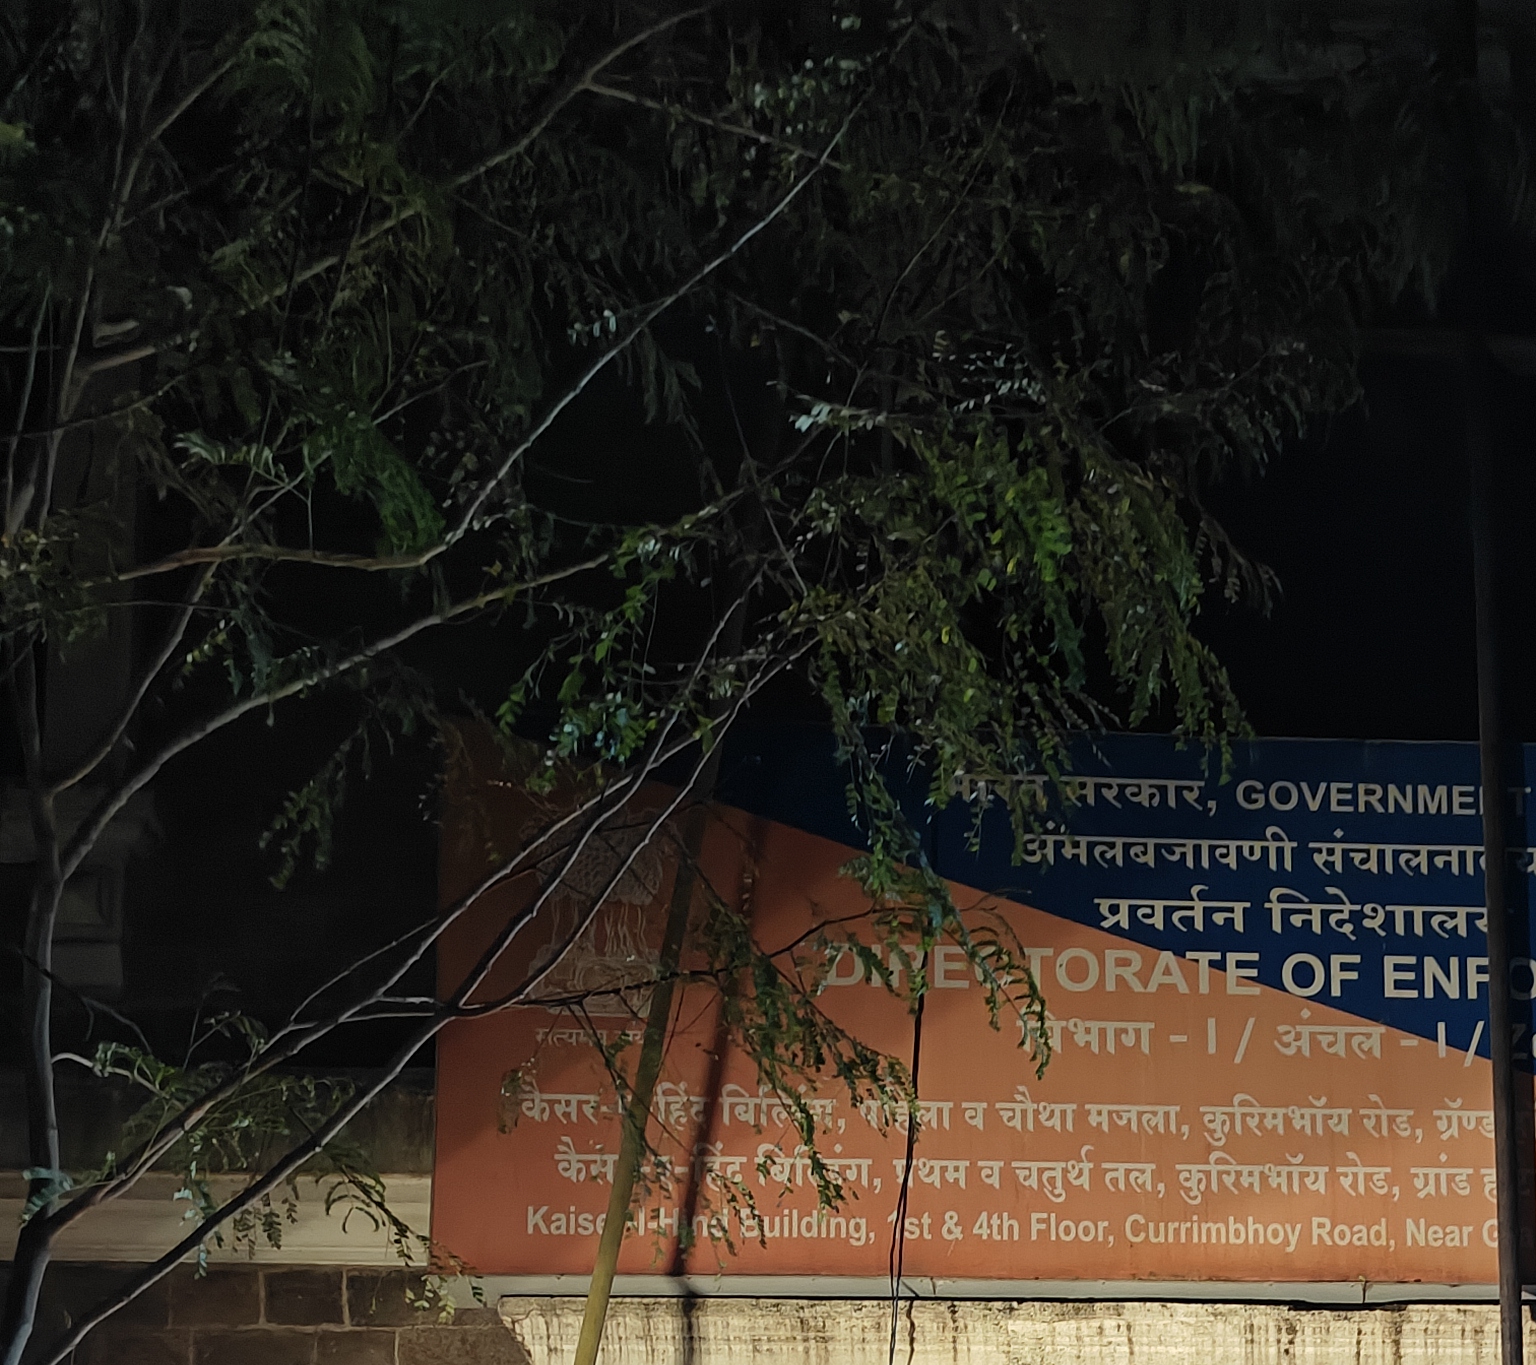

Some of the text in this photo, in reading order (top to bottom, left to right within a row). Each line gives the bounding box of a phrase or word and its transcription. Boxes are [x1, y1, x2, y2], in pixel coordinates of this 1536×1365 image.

[1236, 780, 1532, 816] GOVERNMET
[1094, 884, 1251, 933] प्रवर्तन
[1282, 953, 1361, 997] OF
[1274, 1008, 1386, 1059] अंचल
[963, 1102, 987, 1131] व
[996, 1086, 1077, 1132] चौथा
[1085, 1104, 1191, 1140] मजला,
[1359, 1094, 1423, 1144] रोड,
[978, 1159, 1004, 1190] व
[1011, 1145, 1094, 1202] चतुर्थ
[1101, 1162, 1166, 1199] तल,
[1336, 1152, 1400, 1202] रोड,
[1410, 1153, 1474, 1200] ग्रांड
[527, 1206, 729, 1237] KaiseI-Hnd
[740, 1209, 876, 1247] Building,
[887, 1213, 932, 1241] 1st
[941, 1211, 964, 1242] &
[972, 1211, 1020, 1241] 4th
[1030, 1213, 1114, 1249] Floor,
[1125, 1213, 1302, 1253] Currimbhoy
[1311, 1217, 1396, 1252] Road,
[1406, 1218, 1473, 1249] Near
